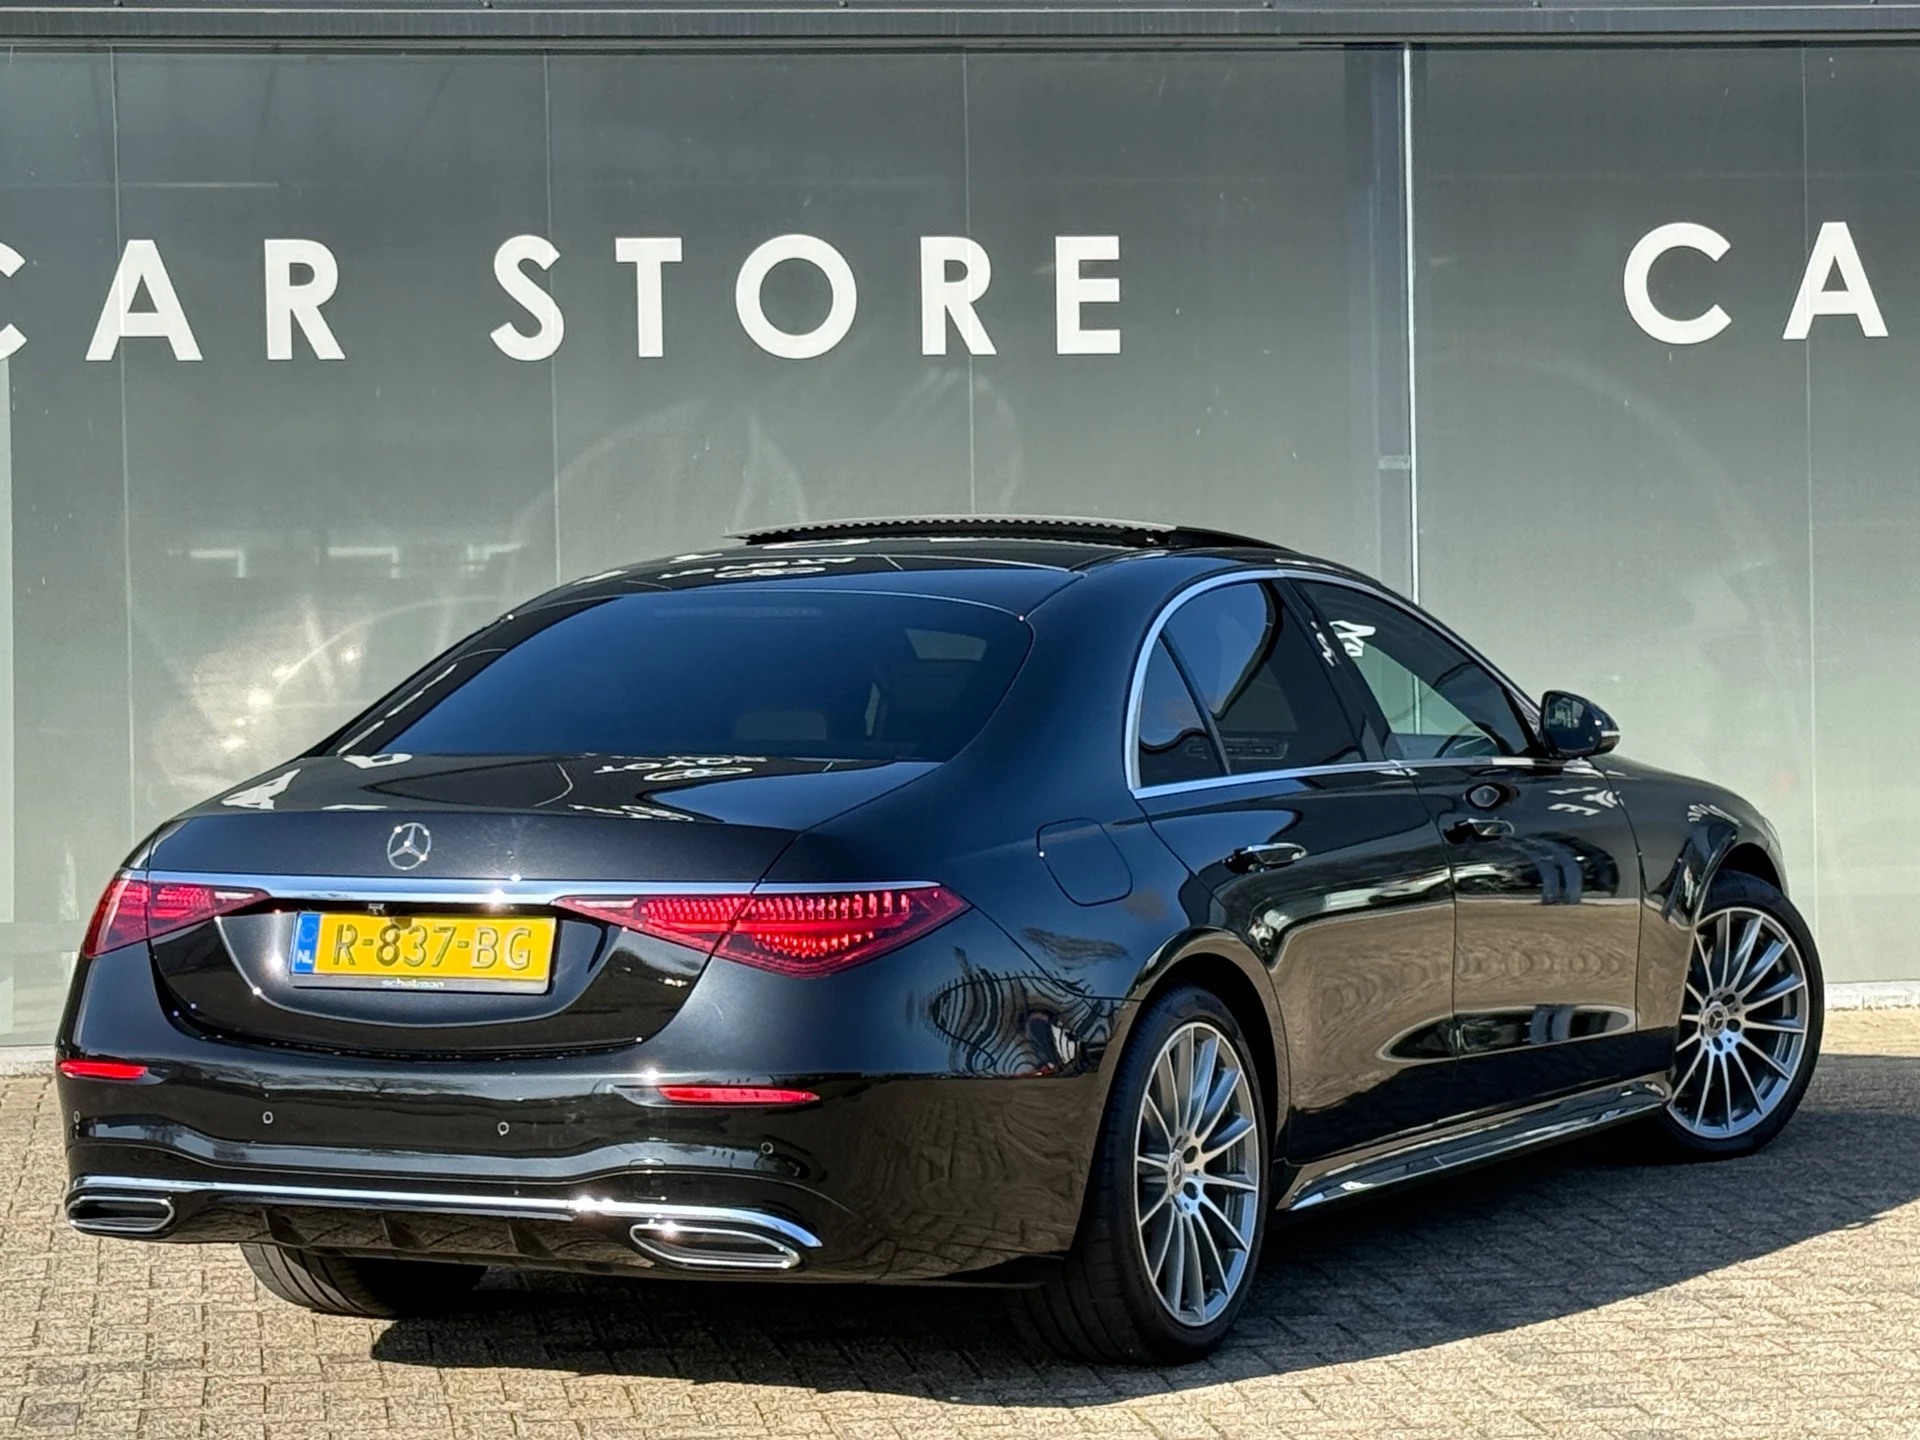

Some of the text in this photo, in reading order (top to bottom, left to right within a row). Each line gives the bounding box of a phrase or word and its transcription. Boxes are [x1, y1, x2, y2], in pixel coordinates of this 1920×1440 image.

[0, 234, 1121, 361] AR STORE
[1623, 221, 1889, 344] CA
[297, 950, 314, 964] NL
[332, 922, 532, 971] R-837-BG
